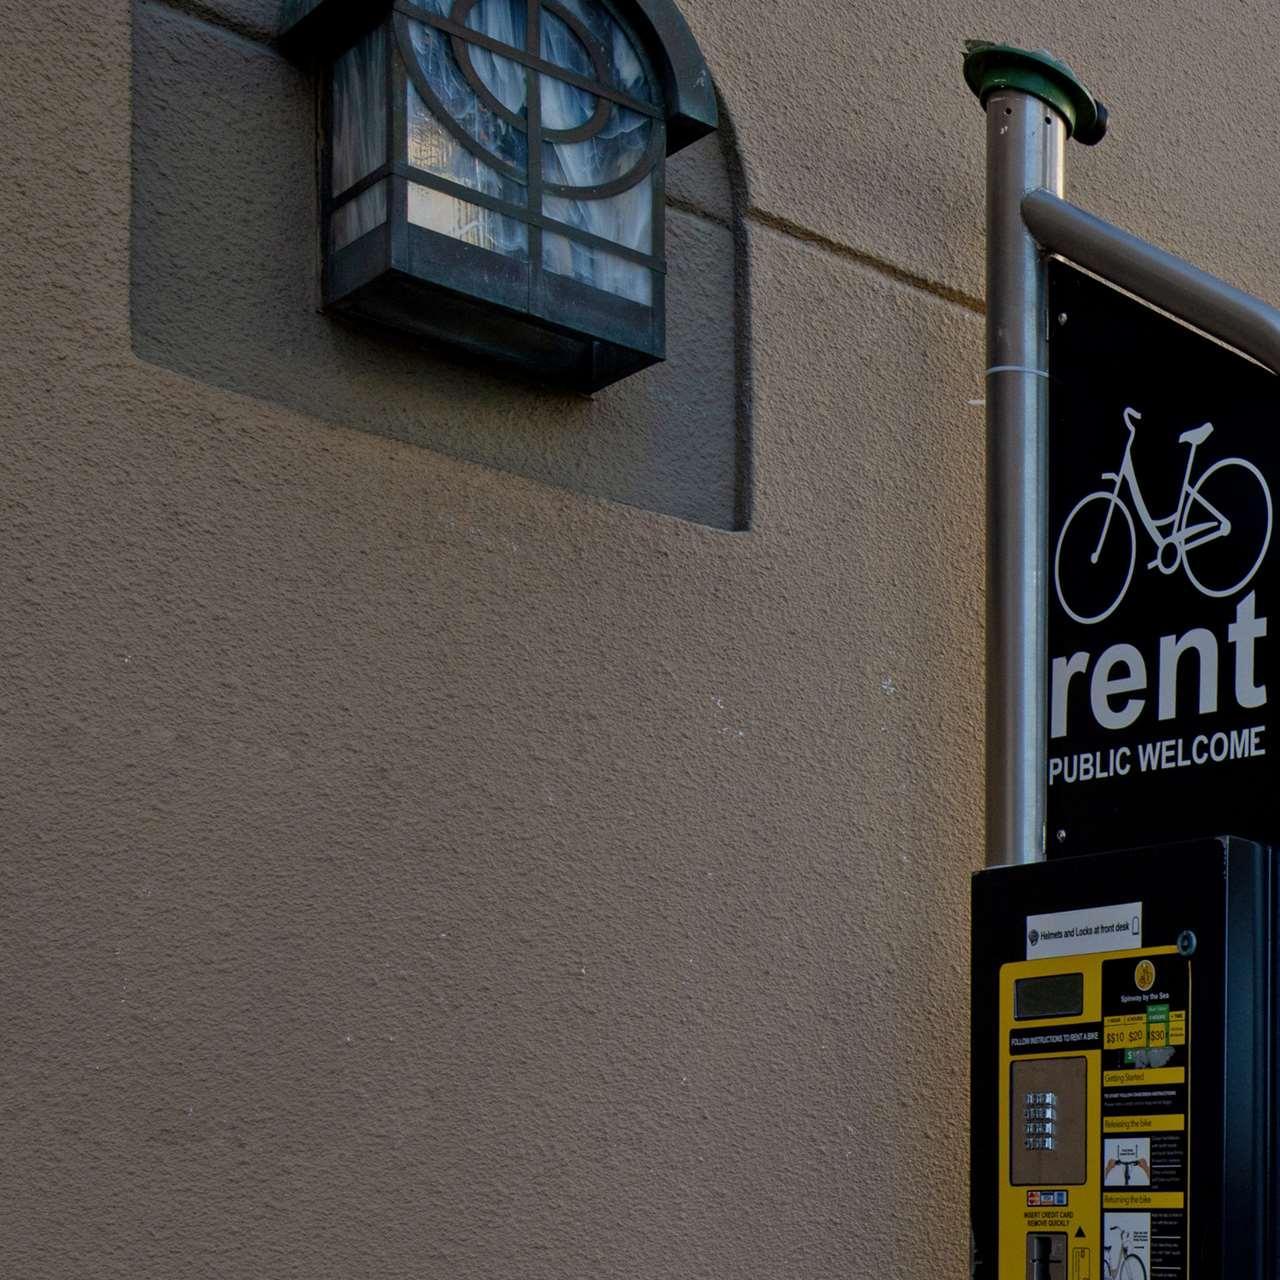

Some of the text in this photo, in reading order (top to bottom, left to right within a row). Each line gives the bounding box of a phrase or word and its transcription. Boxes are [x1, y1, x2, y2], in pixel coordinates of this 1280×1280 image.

[1050, 589, 1267, 739] rent
[1048, 725, 1266, 785] PUBLIC WELCOME
[1040, 930, 1063, 941] Helmets
[1064, 927, 1074, 938] and
[1094, 926, 1100, 935] at
[1100, 923, 1114, 935] front
[1115, 922, 1129, 933] desk
[1149, 992, 1159, 1001] the
[1159, 991, 1169, 1000] Sea
[1128, 1029, 1143, 1042] $20
